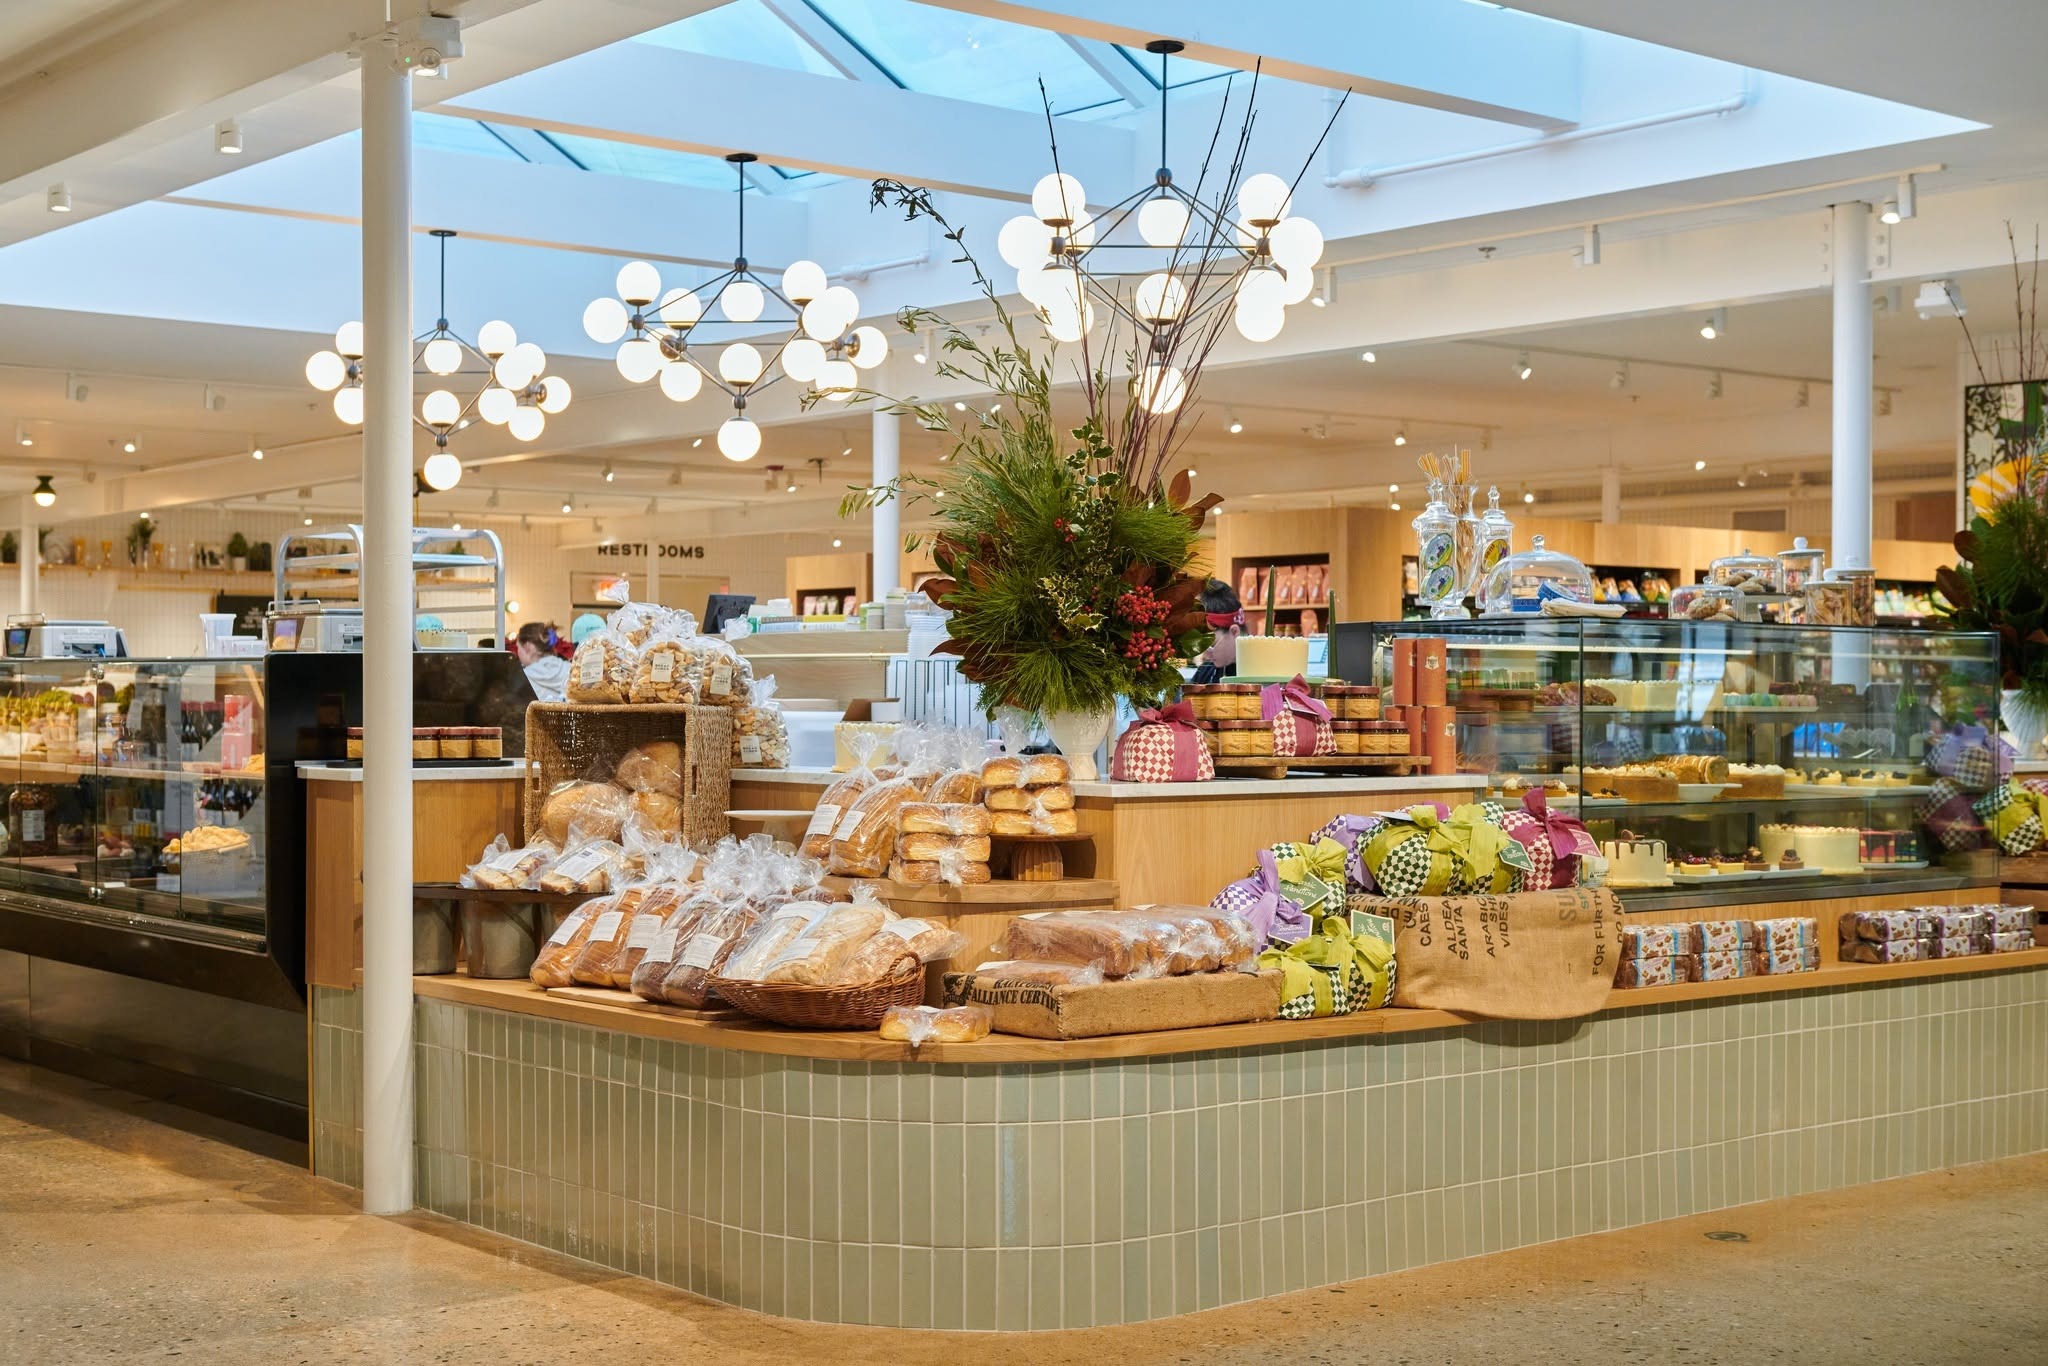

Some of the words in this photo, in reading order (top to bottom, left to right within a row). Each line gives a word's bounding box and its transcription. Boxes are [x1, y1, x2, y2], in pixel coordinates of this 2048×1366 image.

[1441, 900, 1456, 954] ALDEA
[1477, 896, 1496, 958] ARABIC
[1499, 901, 1511, 948] VIDES
[1591, 887, 1604, 940] FURTH
[1611, 893, 1622, 916] NO
[1454, 906, 1469, 960] SANTA
[1592, 944, 1605, 976] FOR
[971, 988, 1019, 1005] ALLIANCE
